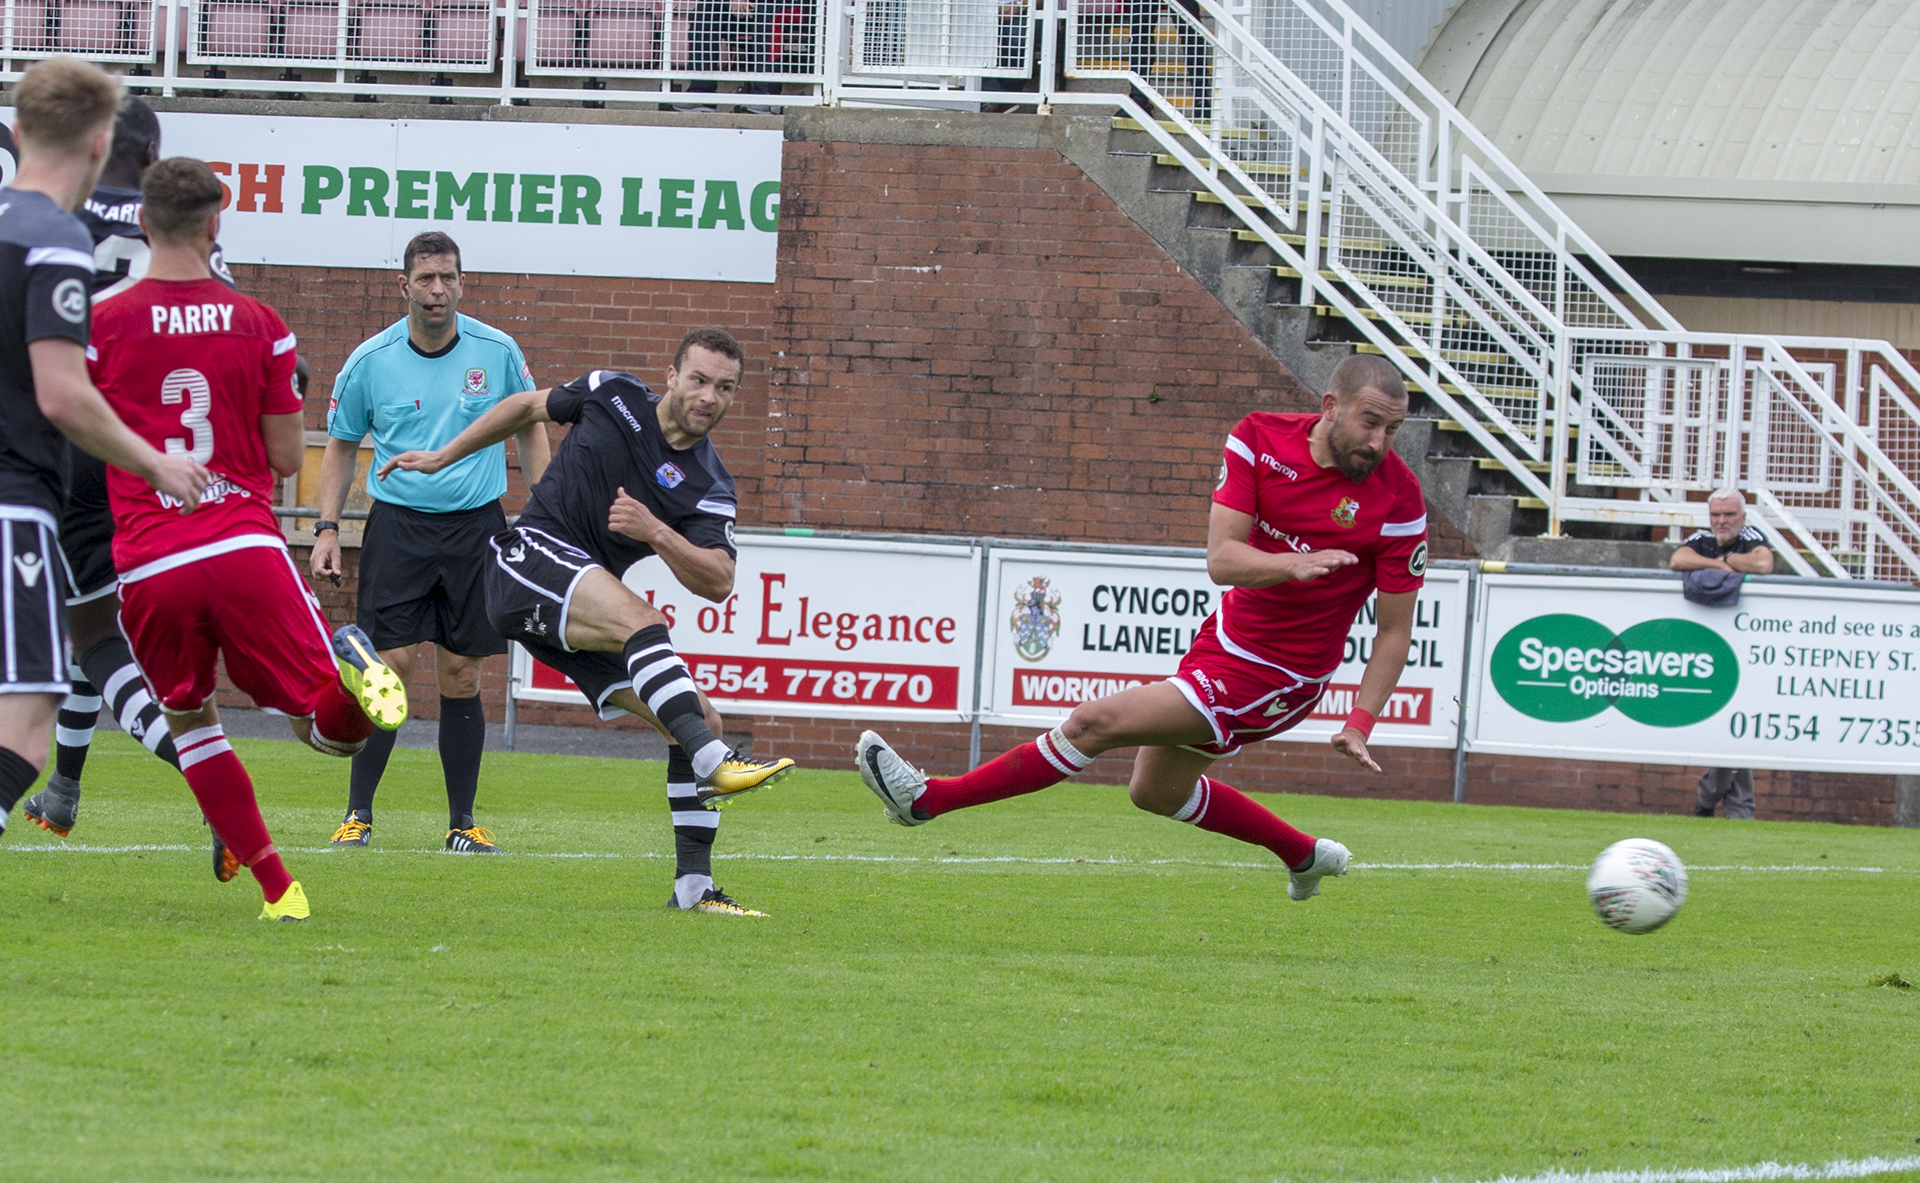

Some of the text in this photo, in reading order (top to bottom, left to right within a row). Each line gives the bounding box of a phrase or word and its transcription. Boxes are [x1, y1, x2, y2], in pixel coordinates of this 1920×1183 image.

[301, 165, 602, 226] PREMIER
[151, 304, 234, 334] PARRY
[161, 368, 214, 466] 3
[610, 395, 642, 432] macron
[697, 594, 739, 634] of
[757, 572, 956, 651] Elegance
[1092, 585, 1210, 617] CYNGOR
[1734, 612, 1793, 633] Come
[1800, 615, 1837, 635] and
[1844, 621, 1876, 636] see
[1882, 623, 1904, 638] us
[1518, 637, 1714, 679] Specsavers
[1748, 645, 1917, 671] 50 STEPNEY ST.
[783, 668, 933, 703] 778770
[1570, 676, 1659, 699] Opticians
[1777, 675, 1885, 700] LLANELLI
[1730, 711, 1820, 742] 01554
